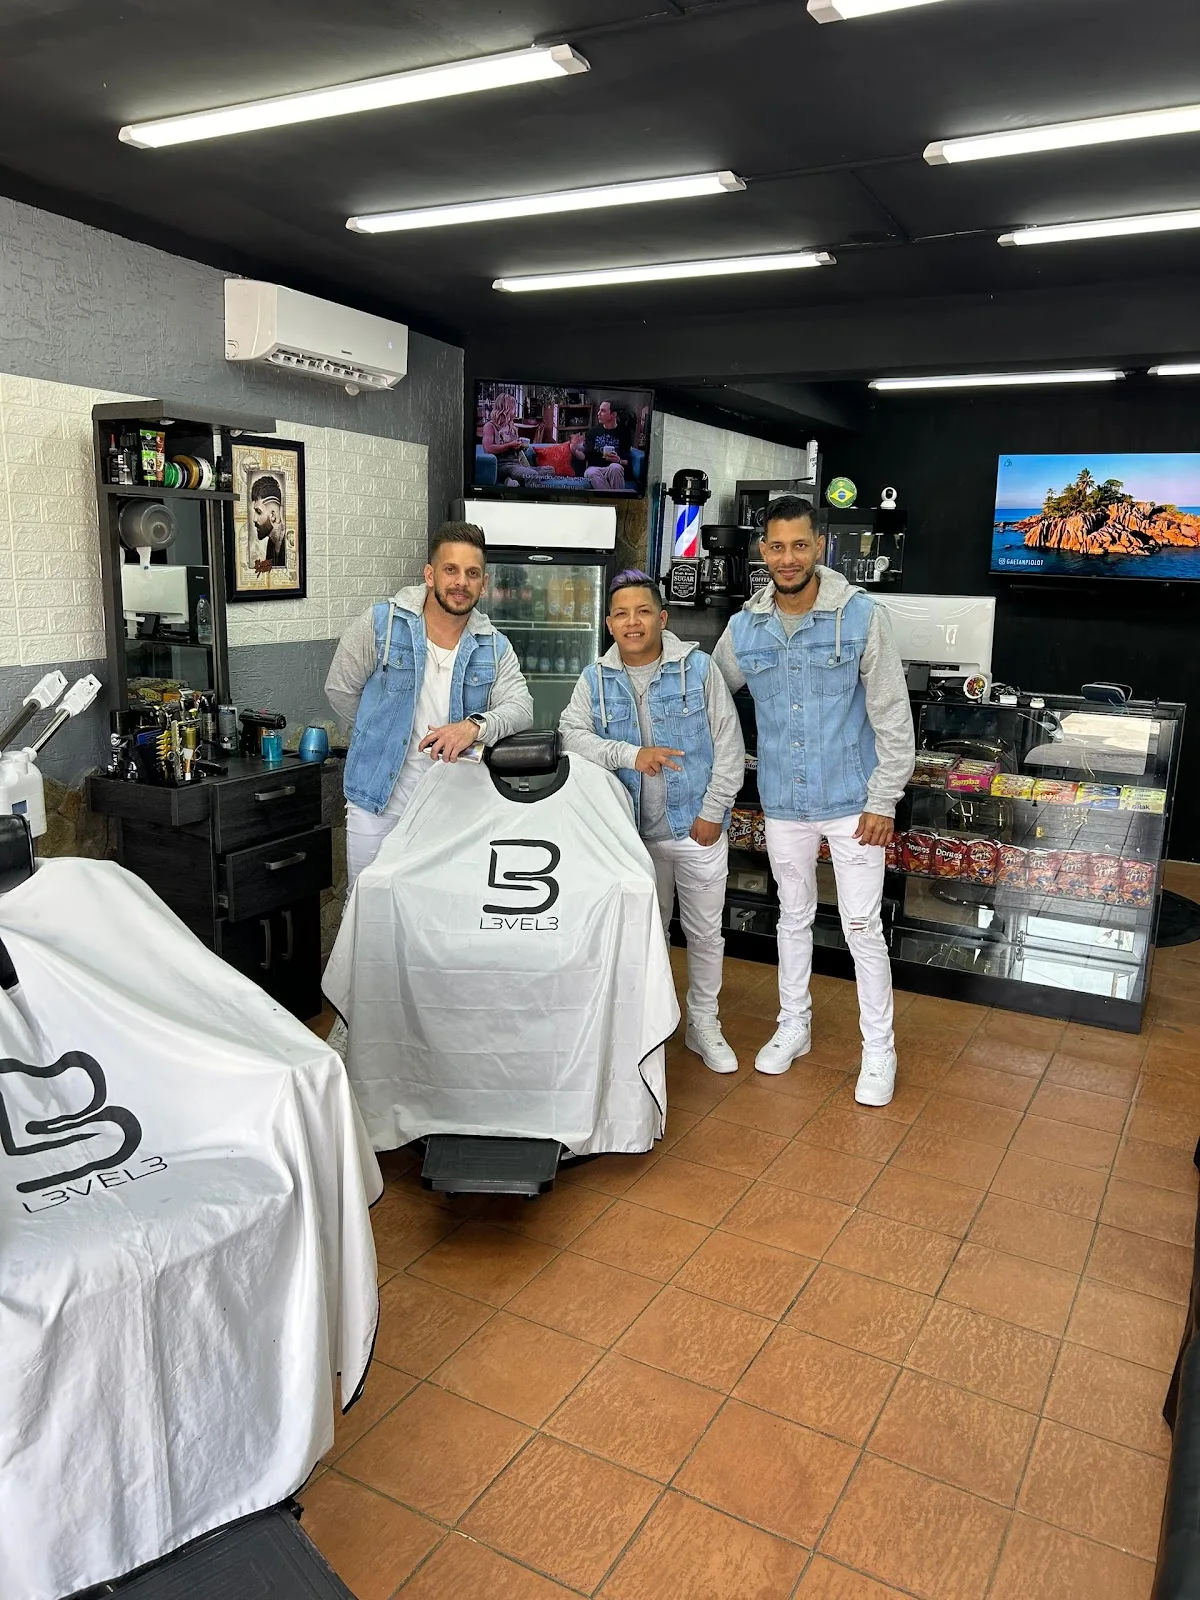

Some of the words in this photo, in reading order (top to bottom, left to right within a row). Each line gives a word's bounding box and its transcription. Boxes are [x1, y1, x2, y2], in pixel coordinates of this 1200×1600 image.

[673, 575, 695, 583] SUGAR
[936, 848, 963, 860] Doritos
[479, 916, 559, 931] L3VEL3
[21, 1156, 168, 1214] L3VEL3
